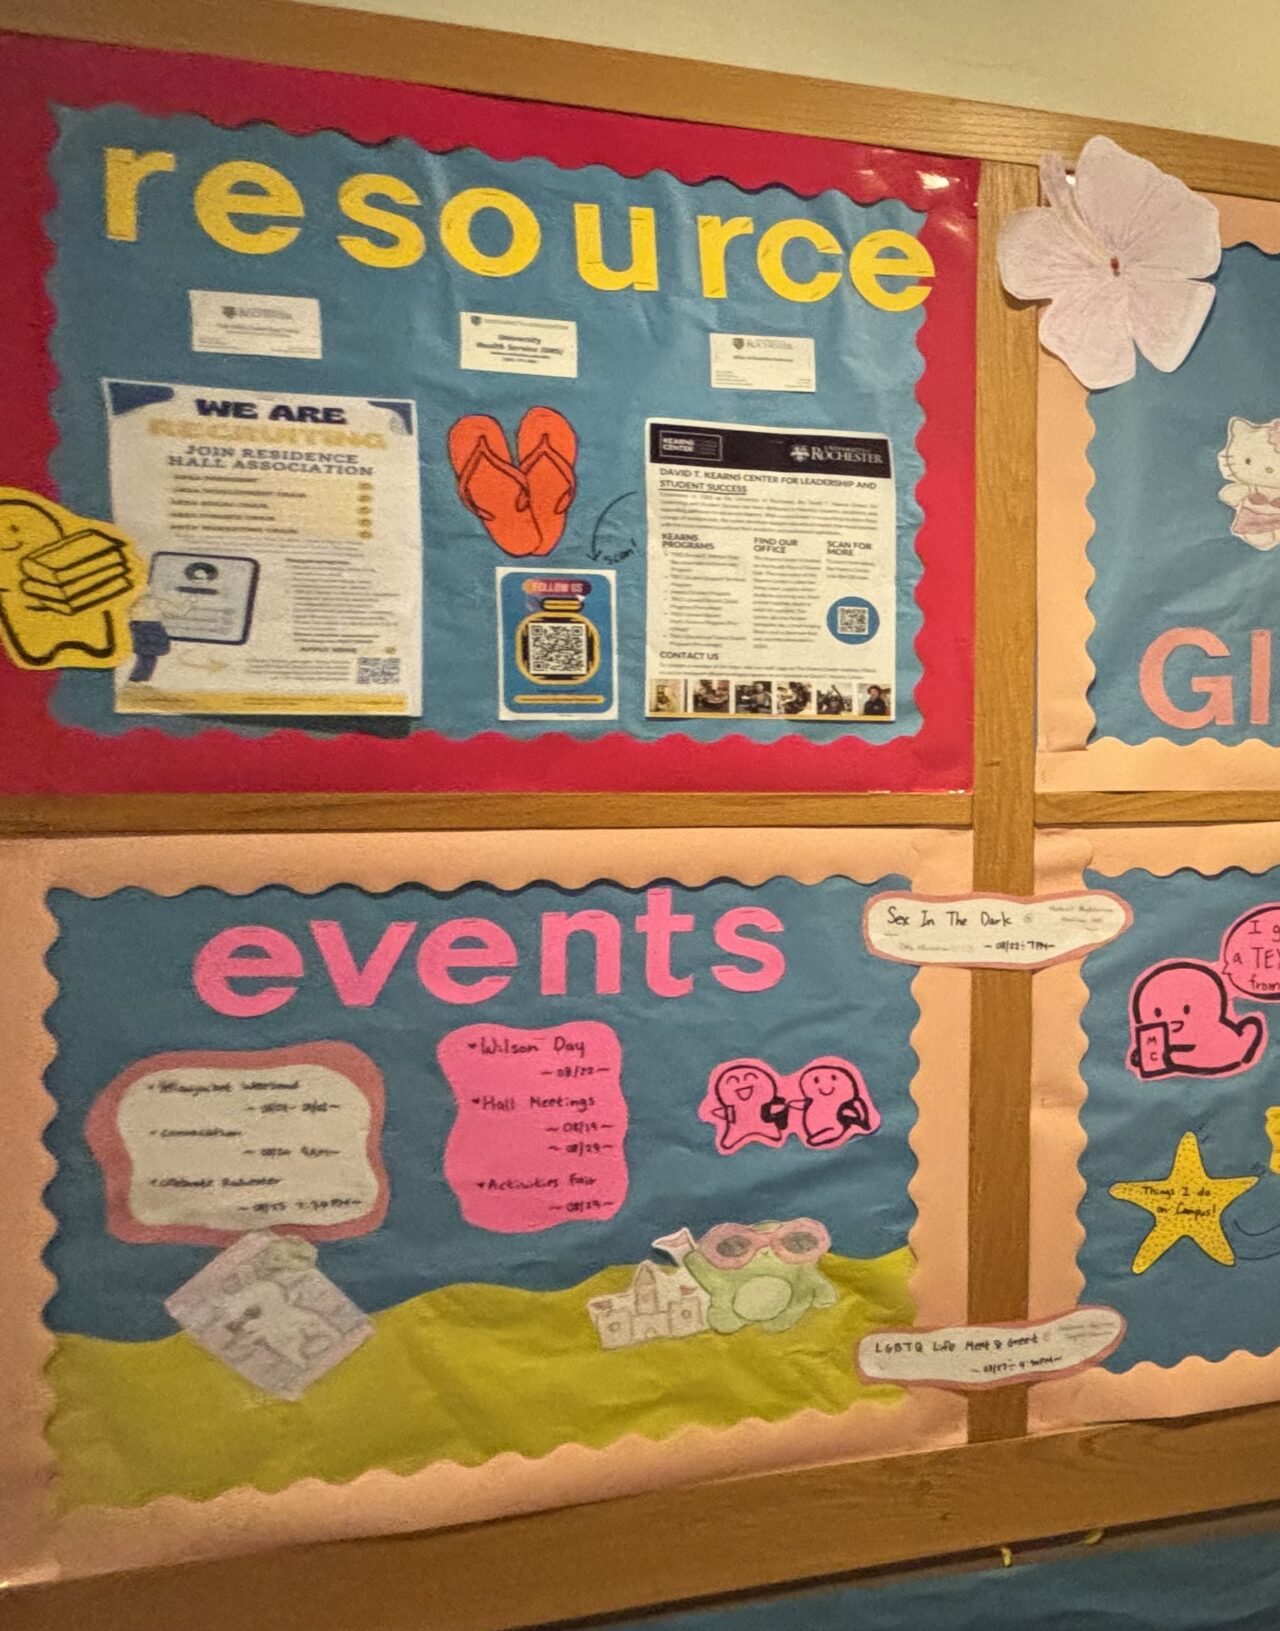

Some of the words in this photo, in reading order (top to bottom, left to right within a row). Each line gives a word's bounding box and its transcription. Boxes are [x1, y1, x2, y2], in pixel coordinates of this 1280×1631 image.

[104, 148, 936, 312] resource
[195, 399, 258, 420] WE
[269, 404, 347, 426] ARE
[184, 445, 235, 458] JOIN
[241, 448, 359, 465] RESIDENCE
[810, 446, 884, 464] ROCHESTER
[167, 455, 228, 469] HALL
[234, 458, 374, 477] ASSOCIATION
[659, 467, 692, 479] DAVID
[704, 471, 742, 482] KEARNS
[743, 473, 779, 484] CENTER
[781, 475, 799, 486] FOR
[800, 477, 854, 489] LEADERSHIP
[856, 481, 878, 490] AND
[659, 479, 705, 491] STUDENT
[707, 482, 748, 494] SUCCESS
[661, 539, 715, 551] PROGRAMS
[753, 537, 777, 547] FIND
[778, 538, 799, 547] OUR
[753, 544, 787, 555] OFFICE
[826, 540, 851, 550] SCAN
[852, 541, 872, 551] FOR
[532, 581, 569, 593] FOLLOW
[571, 582, 584, 593] US
[659, 650, 706, 661] CONTACT
[707, 651, 720, 661] US
[920, 909, 936, 928] In
[945, 910, 968, 927] The
[980, 910, 1013, 927] Dark
[1248, 919, 1262, 936] I
[191, 887, 787, 1018] events
[1232, 952, 1243, 965] a
[481, 1037, 539, 1055] Wilson
[554, 1036, 586, 1058] Day
[1146, 1036, 1157, 1046] M
[1150, 1051, 1159, 1062] C
[481, 1095, 516, 1112] Hall
[529, 1095, 596, 1114] Meetings
[1141, 1185, 1175, 1200] Things
[1181, 1186, 1191, 1197] I
[1196, 1186, 1212, 1197] do
[875, 1341, 924, 1355] LGBTQ
